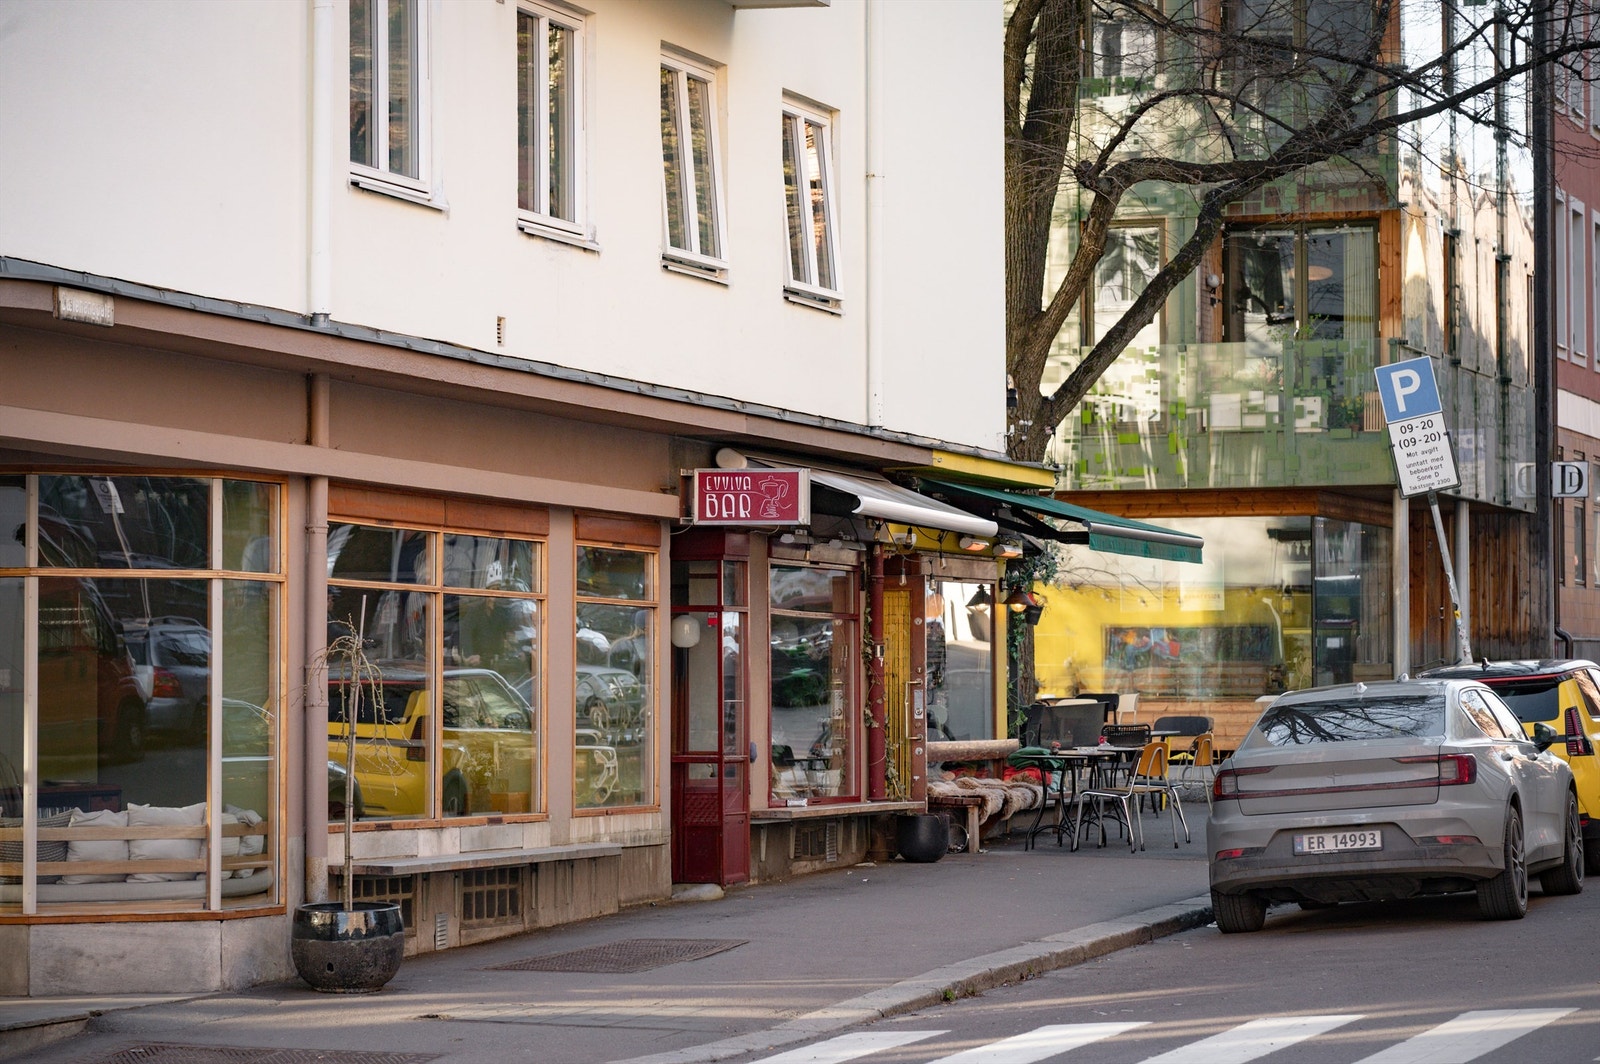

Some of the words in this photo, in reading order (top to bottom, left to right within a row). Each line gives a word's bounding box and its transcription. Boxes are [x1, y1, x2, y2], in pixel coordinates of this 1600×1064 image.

[1390, 368, 1421, 413] P
[1421, 446, 1439, 455] avgift
[1405, 459, 1428, 469] unntatt
[1409, 464, 1444, 475] beboerkort
[705, 476, 751, 490] EVVIVA
[1416, 474, 1432, 482] Sone
[1409, 482, 1435, 490] Takstsone
[705, 493, 751, 518] BAR
[1307, 836, 1326, 850] ER
[1332, 833, 1377, 848] 14993
